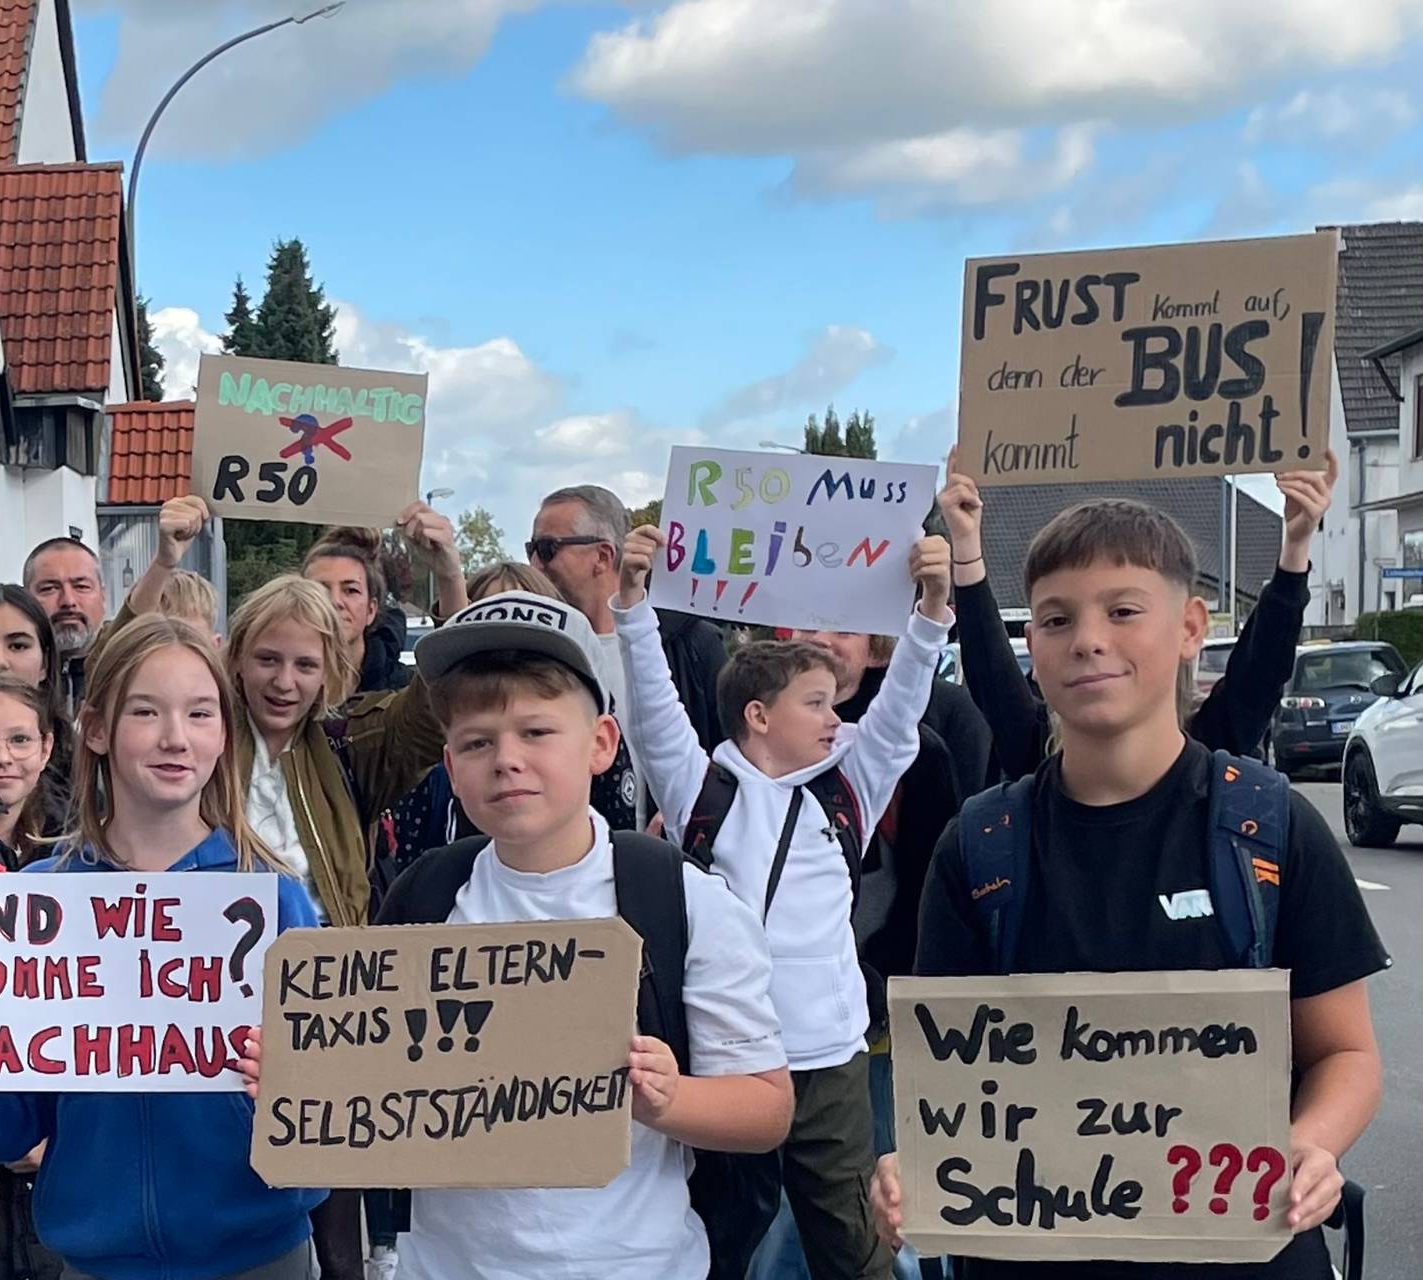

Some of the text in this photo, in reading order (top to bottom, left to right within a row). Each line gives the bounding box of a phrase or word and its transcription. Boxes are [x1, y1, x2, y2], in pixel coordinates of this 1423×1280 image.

[973, 262, 1140, 340] FRUST
[988, 319, 1270, 408] denn der BUS
[218, 371, 423, 425] NACHHALTIG
[983, 414, 1080, 475] kommt
[465, 606, 554, 626] ONS
[280, 949, 399, 1005] KEINE
[284, 1006, 391, 1052] TAXIS
[915, 1003, 1258, 1065] Wie kommen
[267, 1066, 632, 1149] SELBSTSTÄNDIGKEIT
[919, 1080, 1183, 1142] wir zur
[936, 1147, 1144, 1230] Schule
